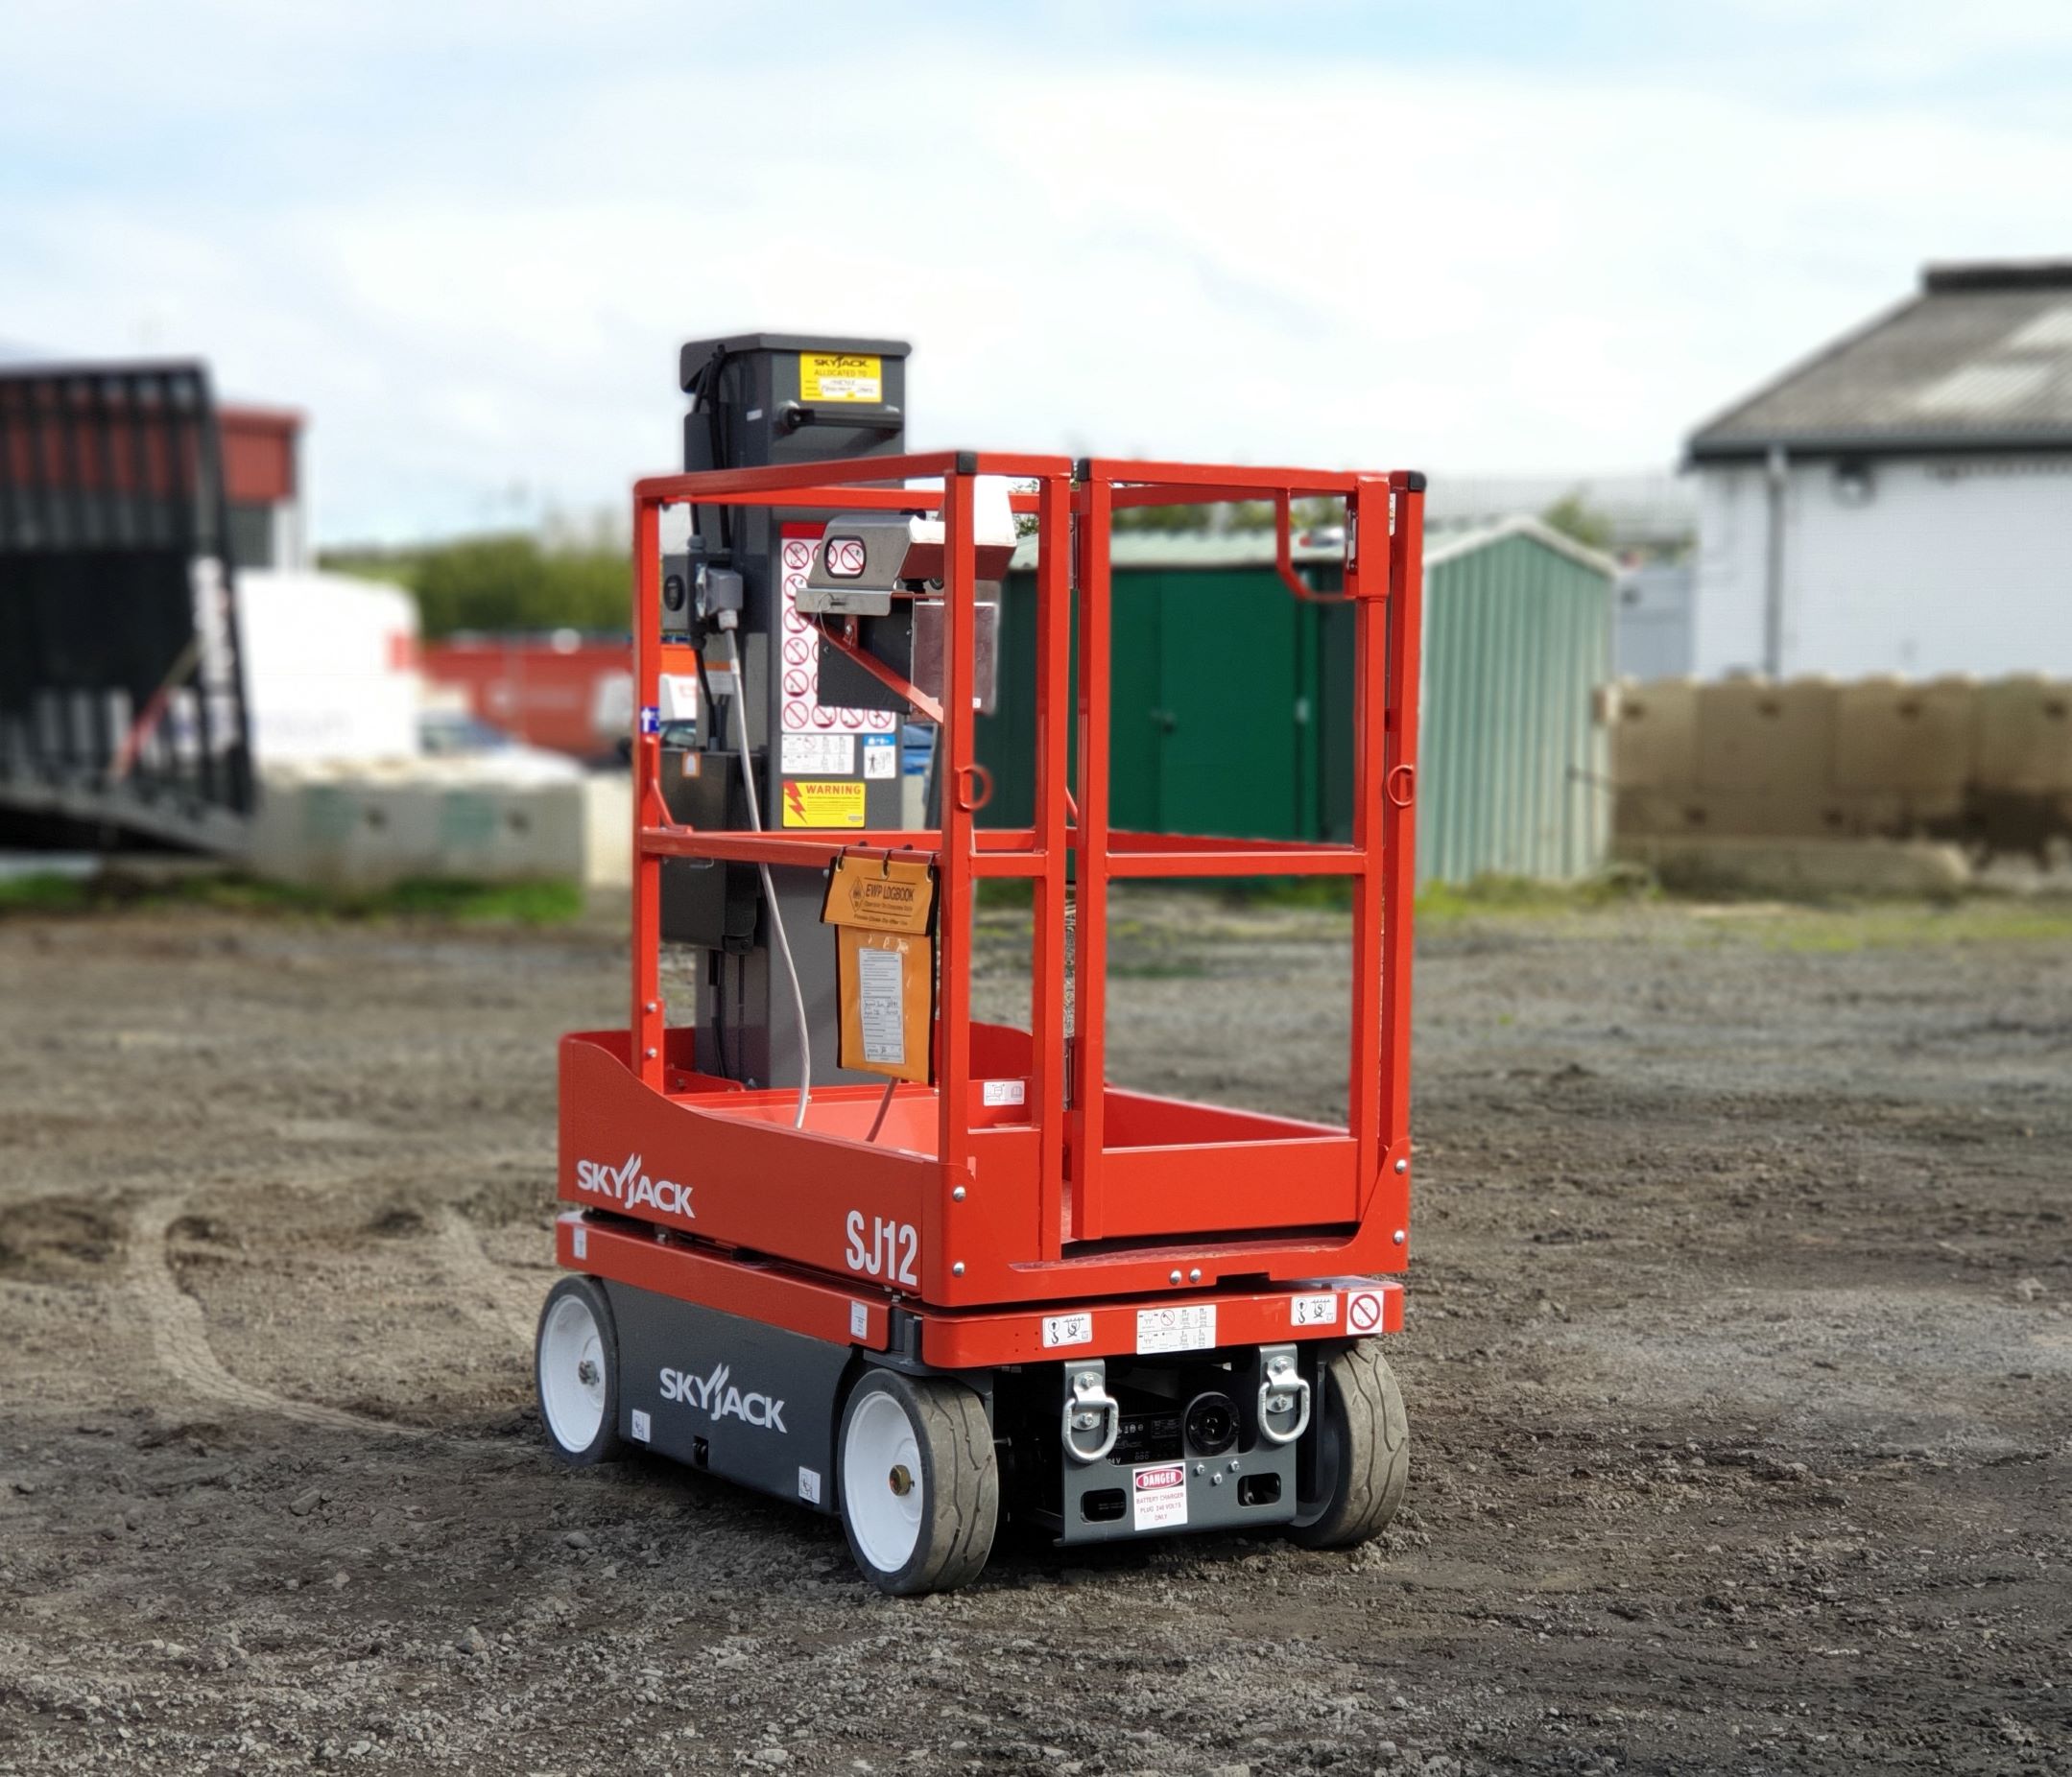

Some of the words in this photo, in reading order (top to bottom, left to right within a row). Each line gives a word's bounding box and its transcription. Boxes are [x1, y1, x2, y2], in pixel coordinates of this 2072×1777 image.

[813, 355, 869, 368] SKYJACK
[814, 368, 856, 378] ALLOCATED
[805, 785, 862, 795] WARNING
[866, 884, 883, 898] EWP
[883, 886, 916, 902] LOGBOOK
[577, 1152, 696, 1219] SKYJACK
[845, 1210, 917, 1287] SJ12
[659, 1362, 788, 1433] SKYJACK
[1142, 1472, 1177, 1487] DANGER
[1159, 1492, 1183, 1502] CHARGER
